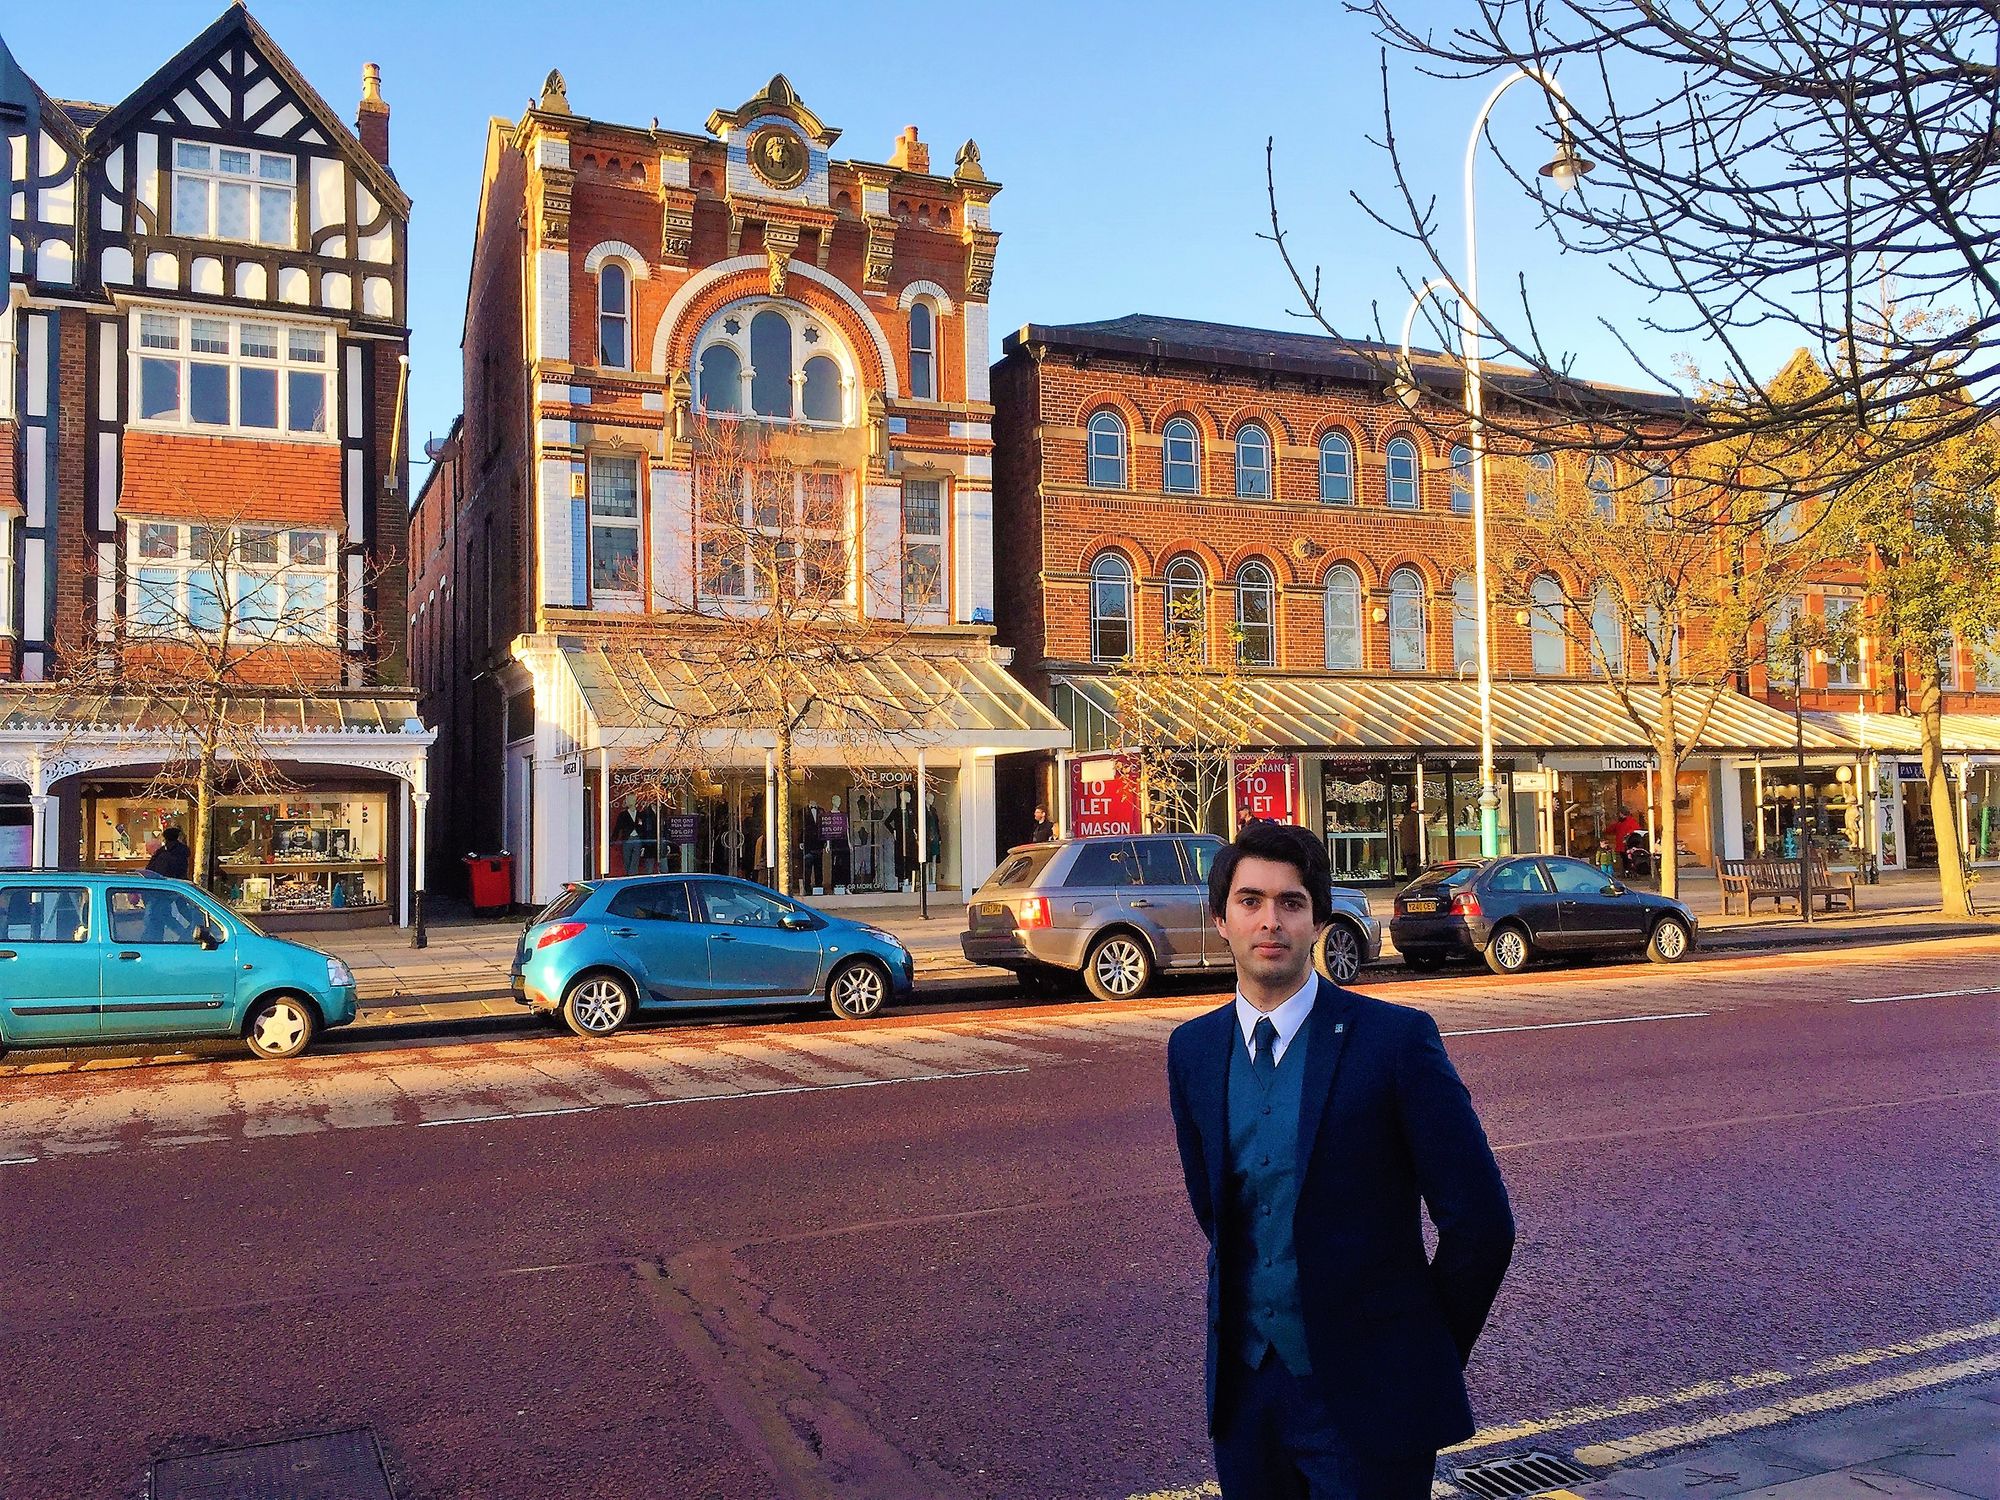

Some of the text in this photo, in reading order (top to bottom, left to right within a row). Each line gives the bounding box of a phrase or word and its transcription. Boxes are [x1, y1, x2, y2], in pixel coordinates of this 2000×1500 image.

[613, 774, 677, 785] SALE ROM
[880, 772, 913, 782] ROOM
[1081, 779, 1106, 796] TO
[1243, 777, 1267, 794] TO
[1080, 798, 1112, 815] LET
[1081, 821, 1130, 835] MASON
